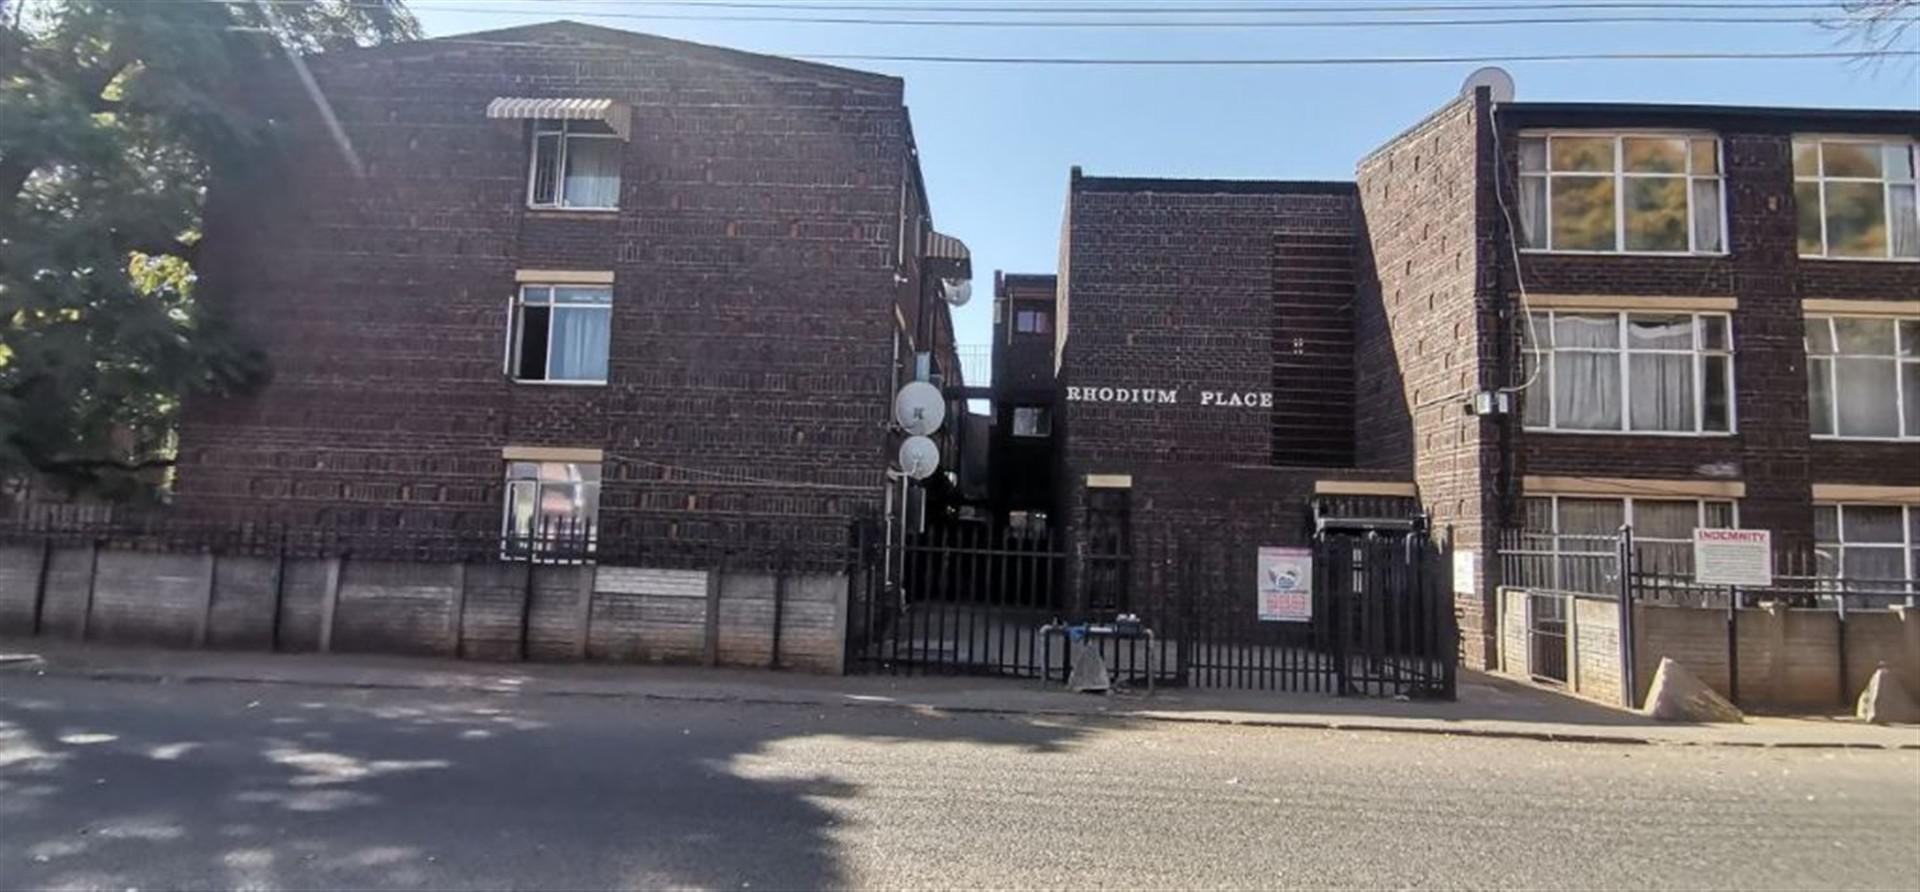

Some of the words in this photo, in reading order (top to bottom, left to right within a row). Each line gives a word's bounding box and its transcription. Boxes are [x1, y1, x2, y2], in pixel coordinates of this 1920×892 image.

[1066, 386, 1178, 404] RHODIUM
[1200, 391, 1274, 408] PLACE
[1699, 530, 1767, 541] INDEMNITY
